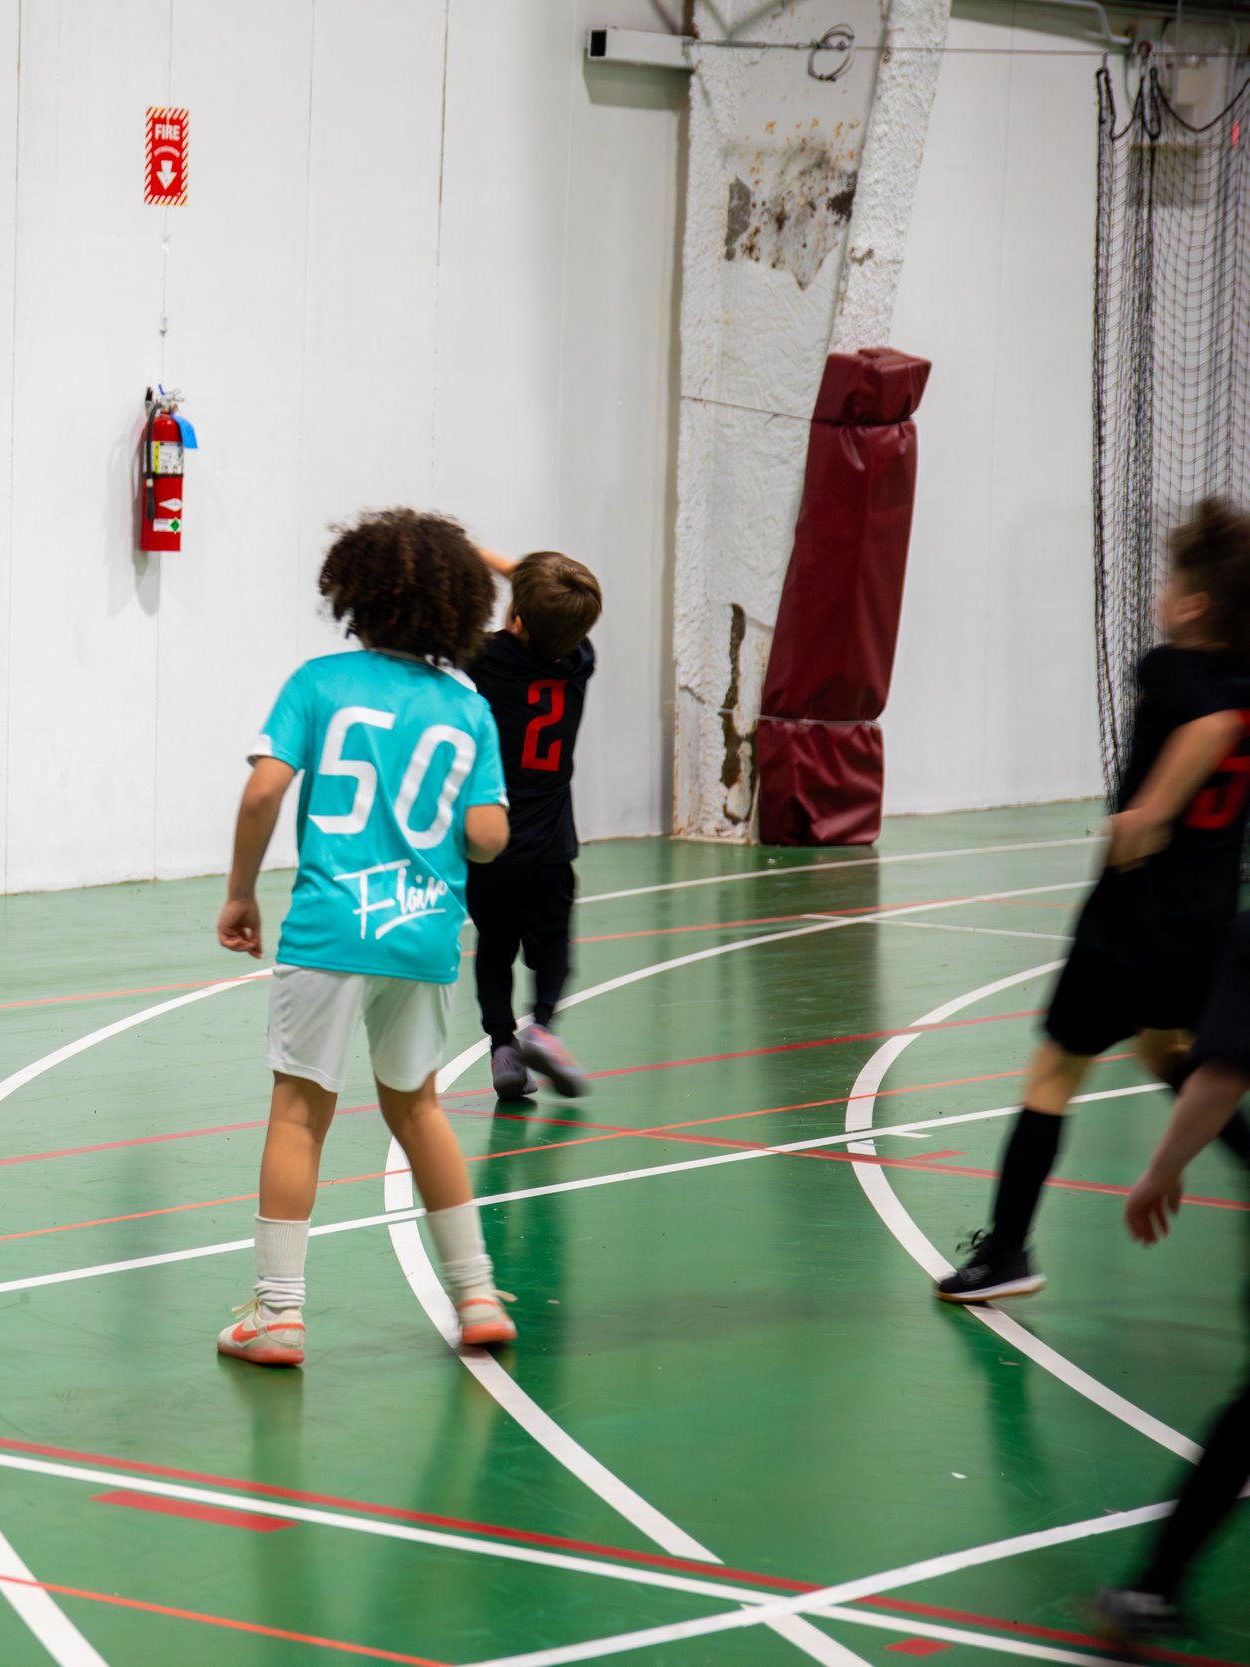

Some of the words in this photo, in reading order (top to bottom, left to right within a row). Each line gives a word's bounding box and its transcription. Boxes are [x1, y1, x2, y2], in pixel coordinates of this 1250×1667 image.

[155, 123, 180, 140] FIRE
[521, 678, 567, 771] 2
[308, 706, 476, 849] 50
